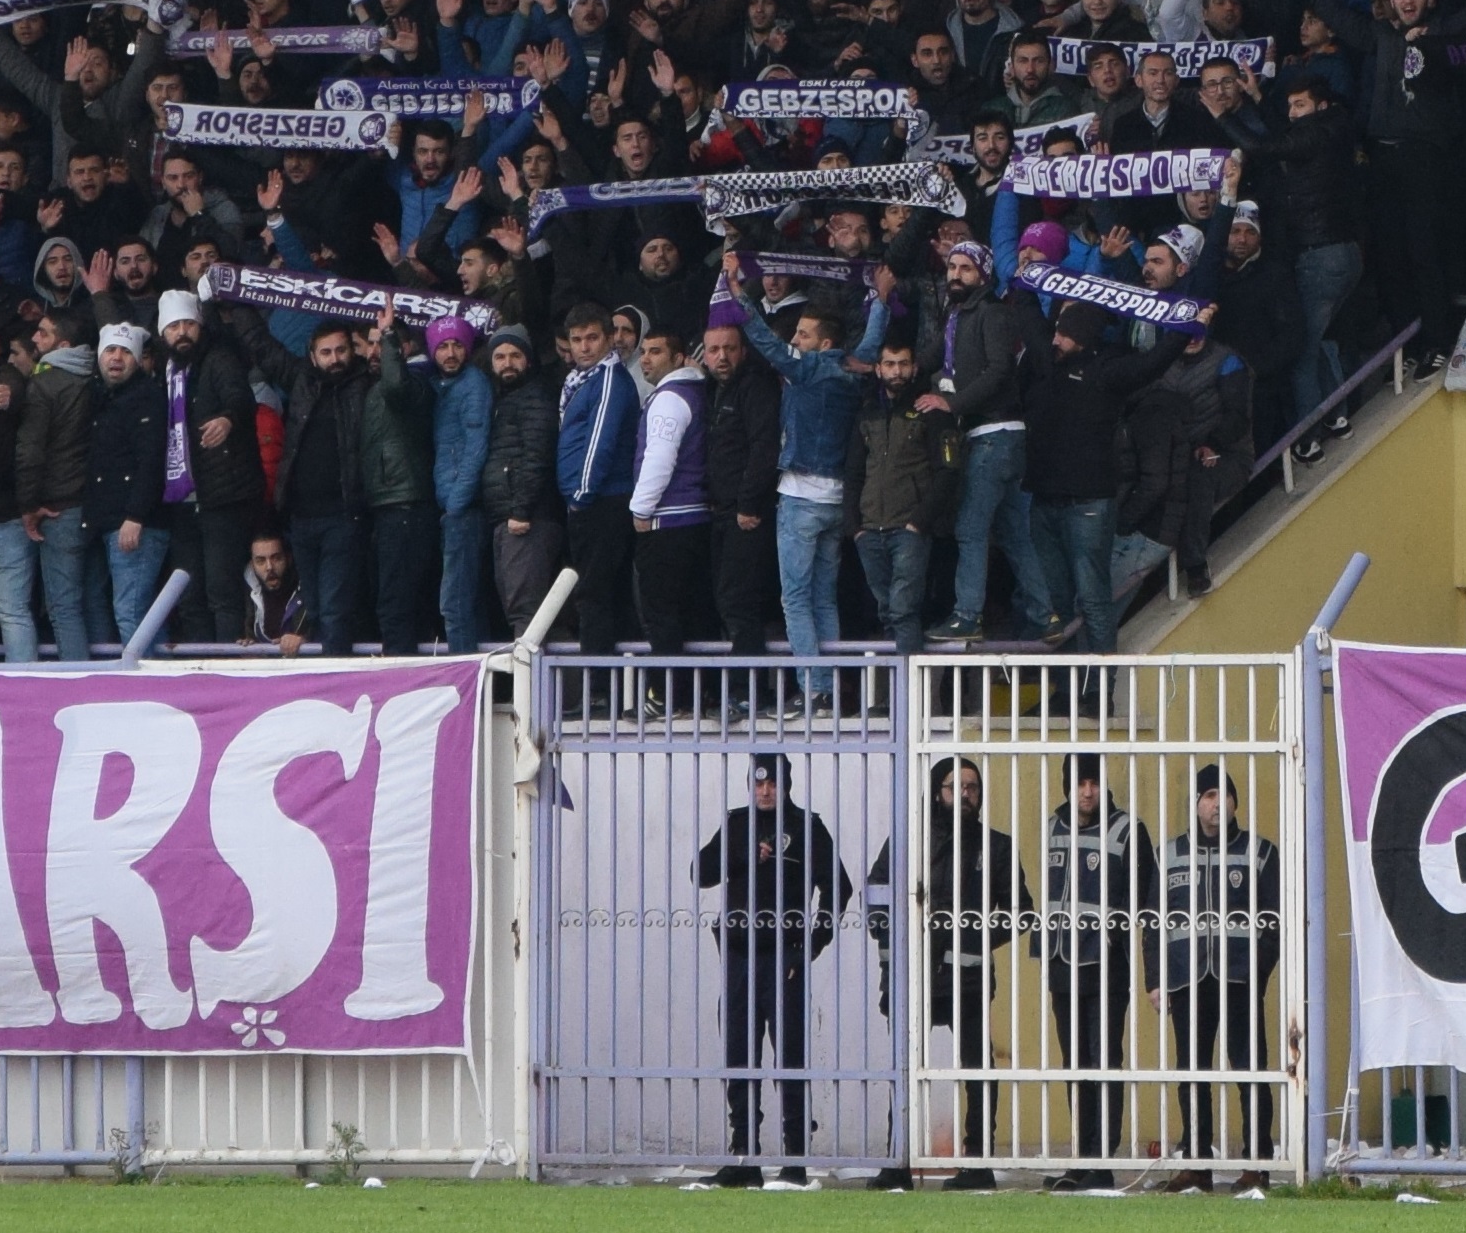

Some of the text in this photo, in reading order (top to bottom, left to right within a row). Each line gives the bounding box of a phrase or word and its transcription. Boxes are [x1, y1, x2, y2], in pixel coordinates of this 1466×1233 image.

[372, 94, 514, 114] GEBZESOR
[738, 88, 909, 113] GEBZESPOR
[1032, 150, 1195, 198] GEBZESPOR
[1041, 276, 1171, 323] GEBZESPOR
